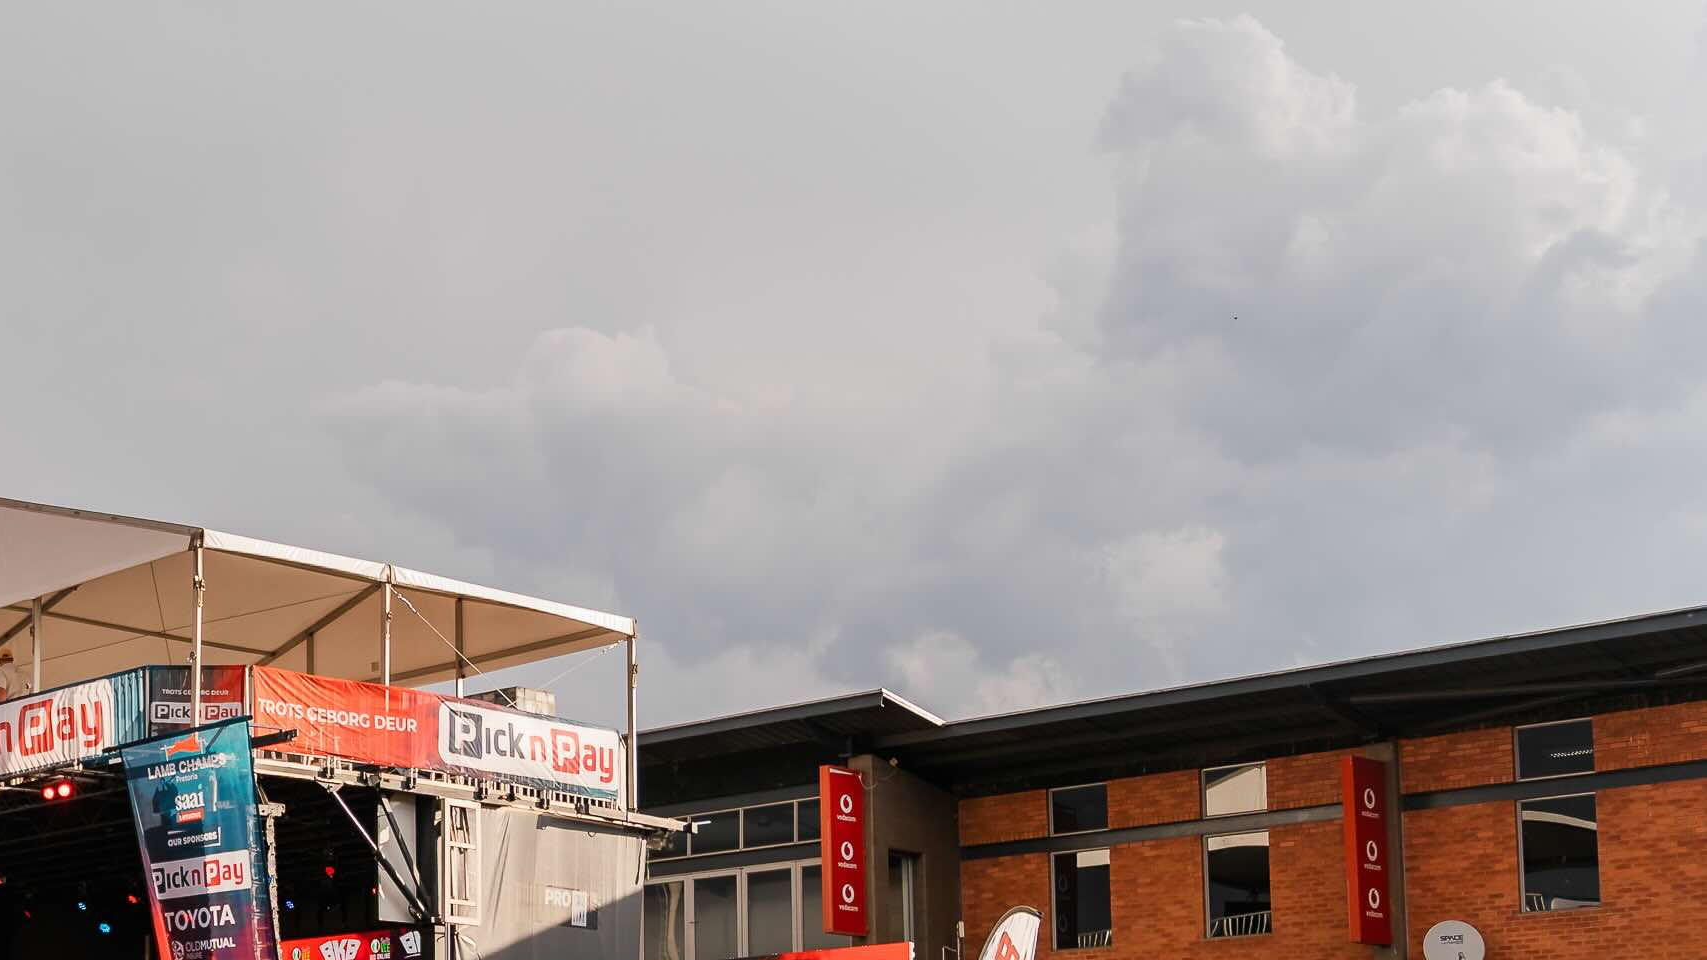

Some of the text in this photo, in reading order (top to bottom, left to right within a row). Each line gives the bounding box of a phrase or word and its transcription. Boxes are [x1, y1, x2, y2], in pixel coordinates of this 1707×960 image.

[162, 688, 182, 696] TROTS
[155, 704, 191, 719] Pick
[205, 705, 239, 720] Pay
[258, 699, 418, 733] TROTS GEBORG DEUR
[18, 698, 102, 757] Pay
[448, 711, 614, 783] Pick n Pay
[147, 753, 226, 780] LAMB CHAMPS
[174, 783, 205, 811] saai
[167, 831, 218, 847] OUR SPONSORS
[152, 859, 244, 894] Pick n Pay
[165, 904, 236, 932] TOYOTA
